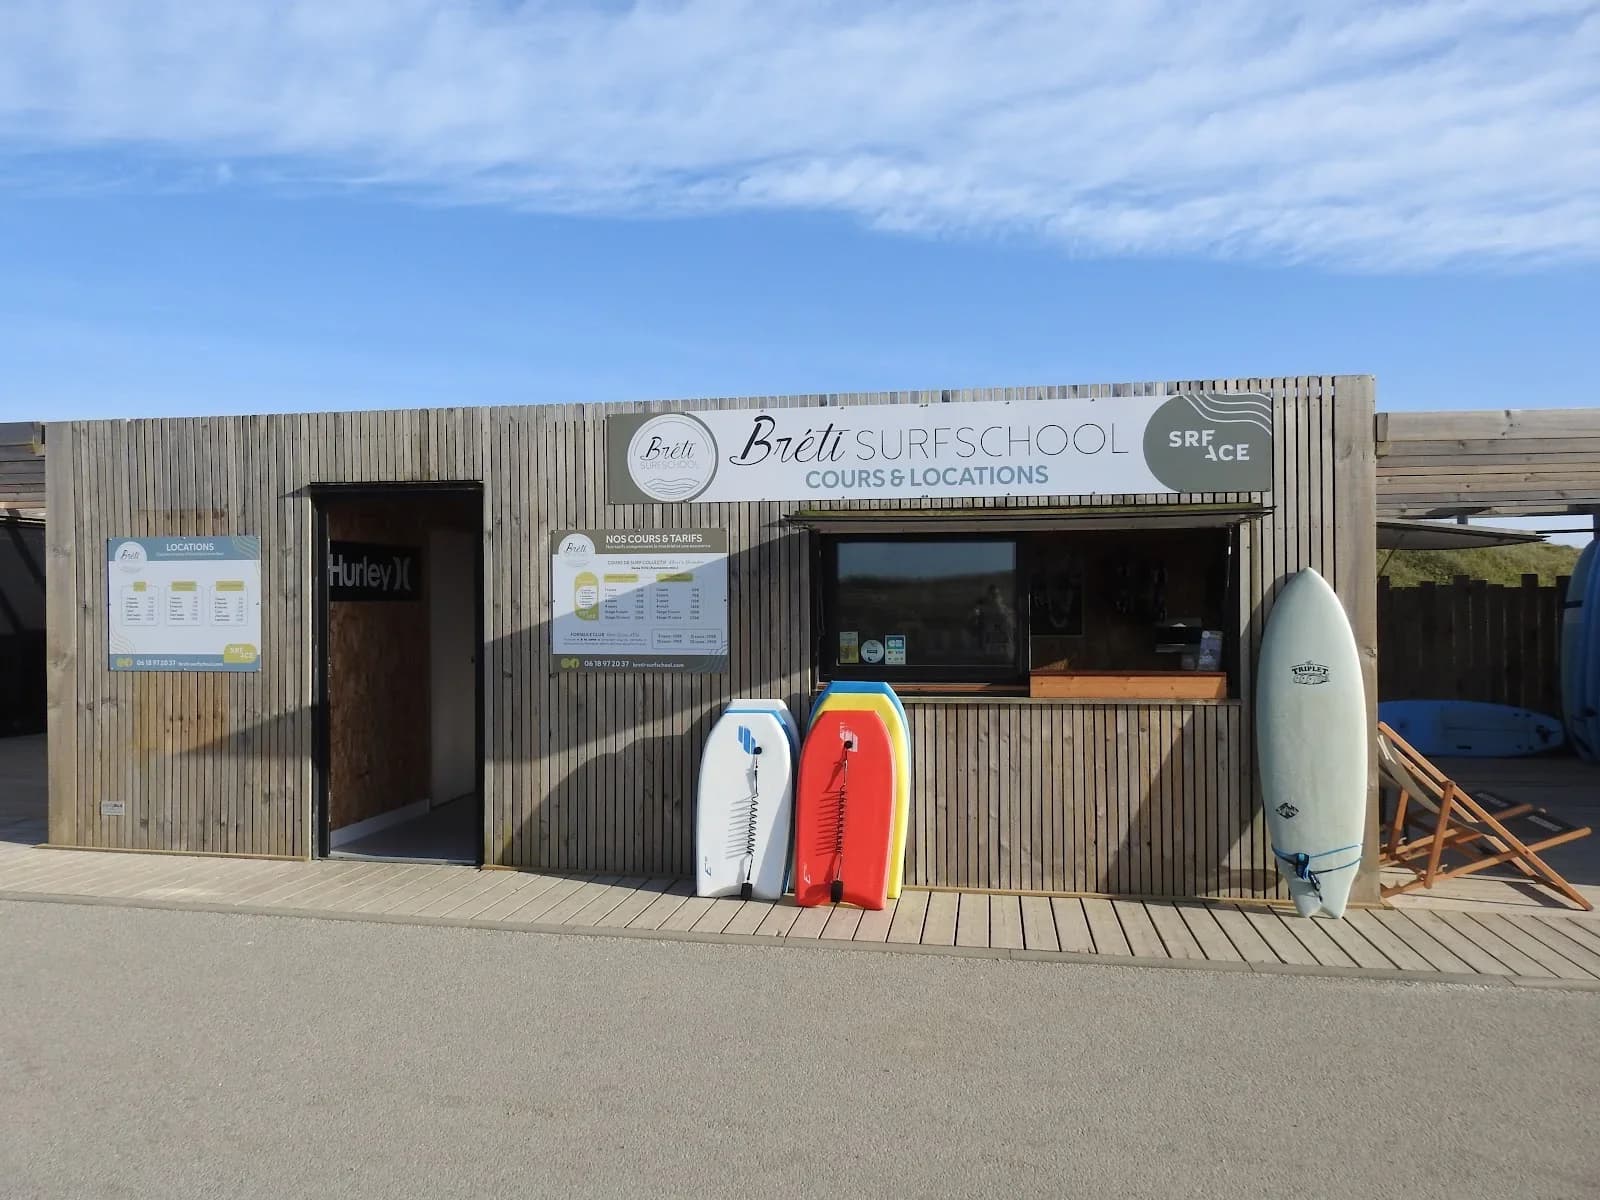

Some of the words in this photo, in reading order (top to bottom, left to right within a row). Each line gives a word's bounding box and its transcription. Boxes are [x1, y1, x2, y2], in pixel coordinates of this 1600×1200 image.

[729, 414, 850, 466] Bréti
[856, 422, 1129, 461] SURFSCHOOL
[1169, 429, 1215, 448] SRF
[640, 436, 697, 461] Bréti
[1204, 444, 1250, 462] ACE
[805, 468, 886, 489] COURS
[890, 468, 905, 487] &
[911, 465, 1049, 487] LOCATIONS
[166, 543, 215, 552] LOCATIONS
[606, 535, 627, 544] NOS
[628, 534, 661, 543] COURS
[662, 534, 669, 543] &
[670, 534, 703, 543] TARIFS
[328, 553, 392, 591] Hurley
[1291, 665, 1329, 675] TRIPLET
